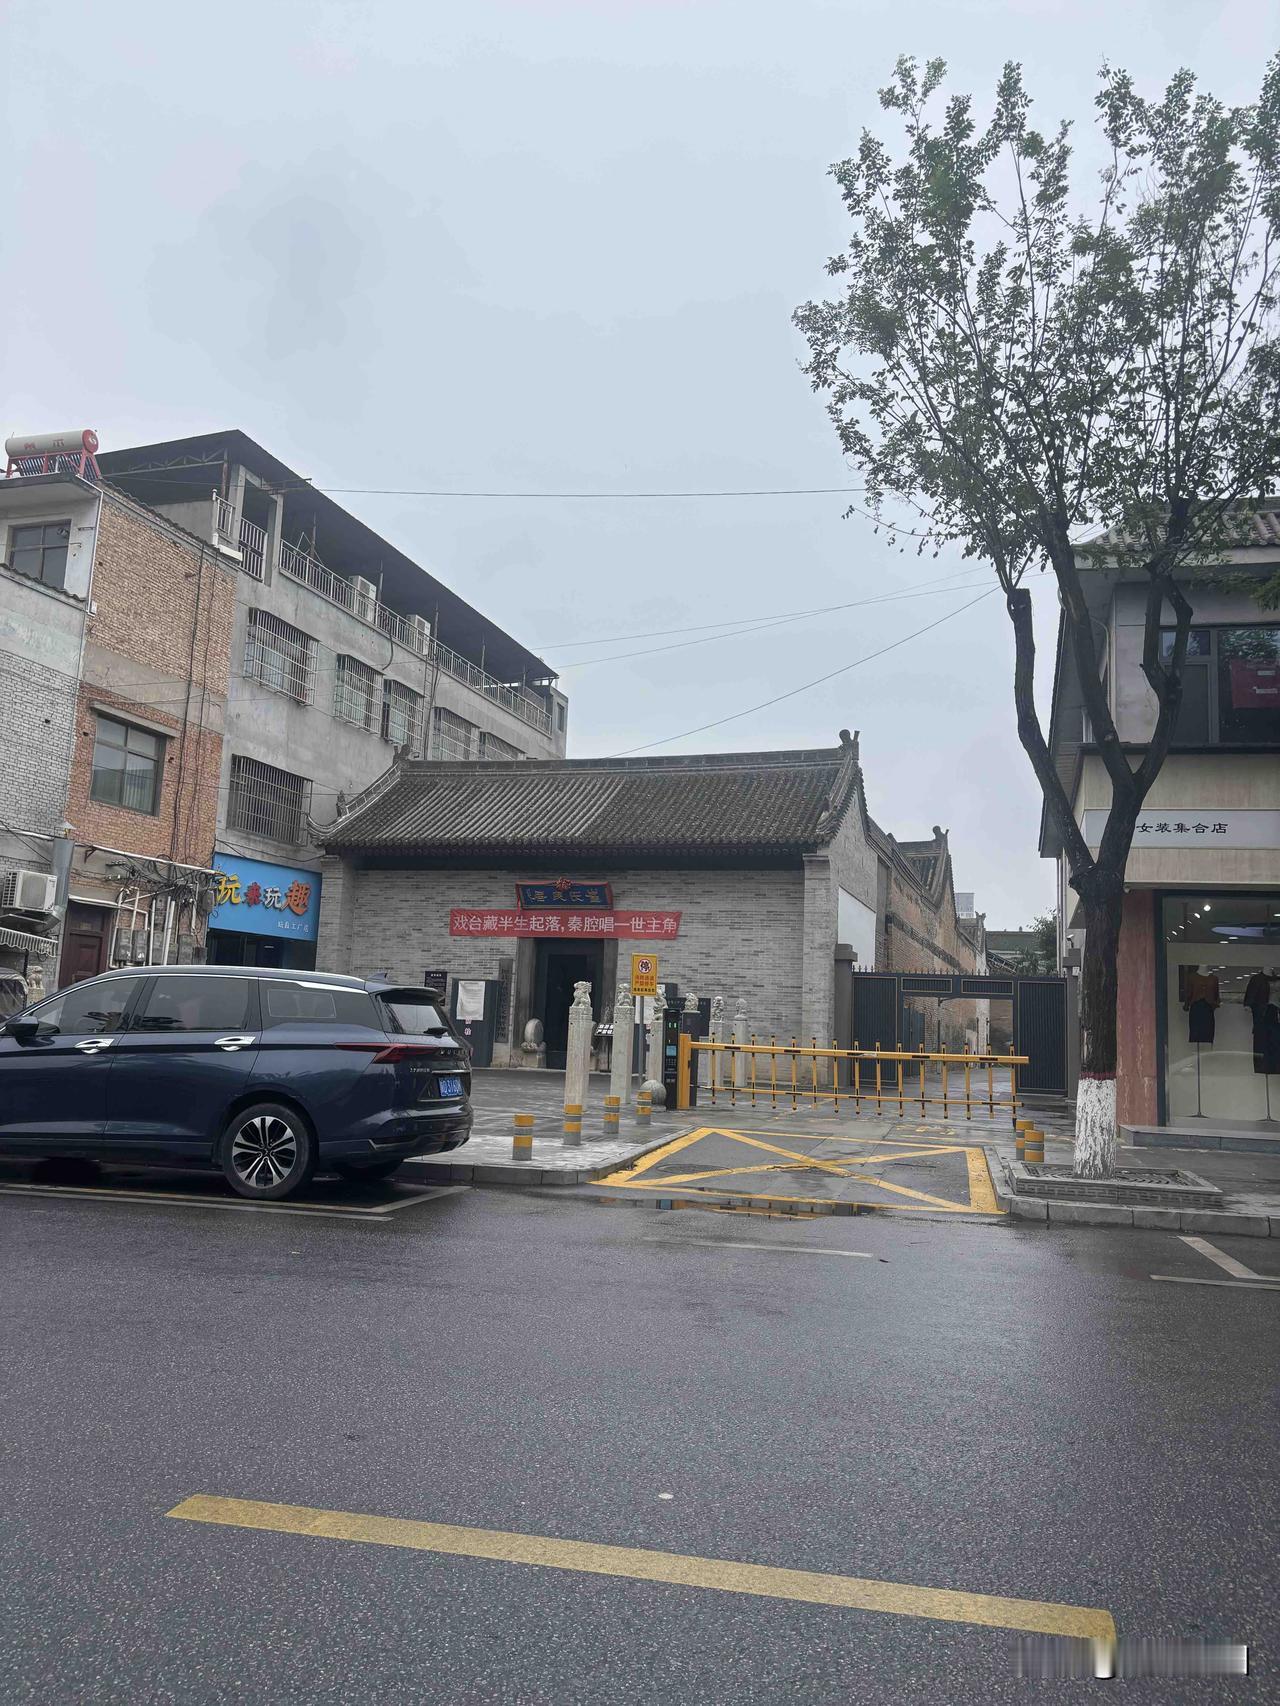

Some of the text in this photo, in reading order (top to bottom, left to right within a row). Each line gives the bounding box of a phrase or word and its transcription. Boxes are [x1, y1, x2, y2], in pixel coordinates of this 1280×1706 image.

[1136, 822, 1229, 835] 女装集合店
